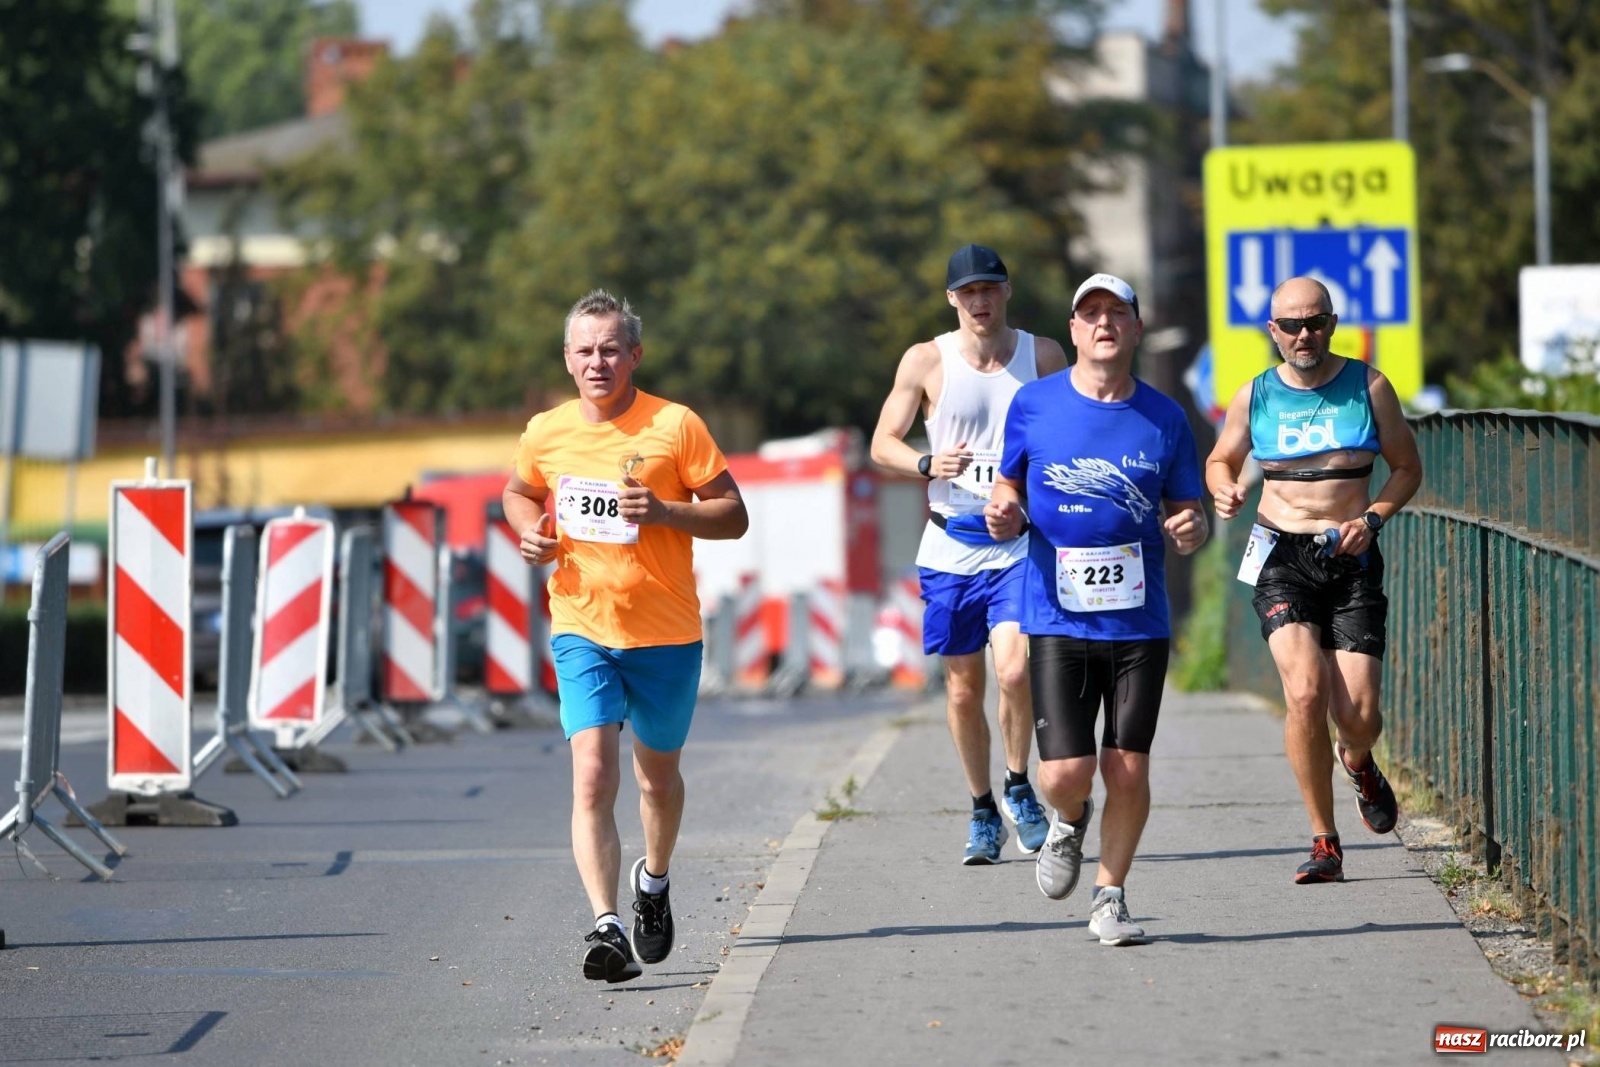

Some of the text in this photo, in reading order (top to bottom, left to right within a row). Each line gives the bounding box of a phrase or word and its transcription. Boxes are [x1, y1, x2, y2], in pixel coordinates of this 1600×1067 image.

[1229, 162, 1389, 206] Uwaga
[1278, 407, 1339, 419] BiegamBLubię
[1278, 418, 1341, 455] bbl
[974, 465, 996, 483] 11
[581, 496, 619, 517] 308
[1084, 563, 1124, 586] 223
